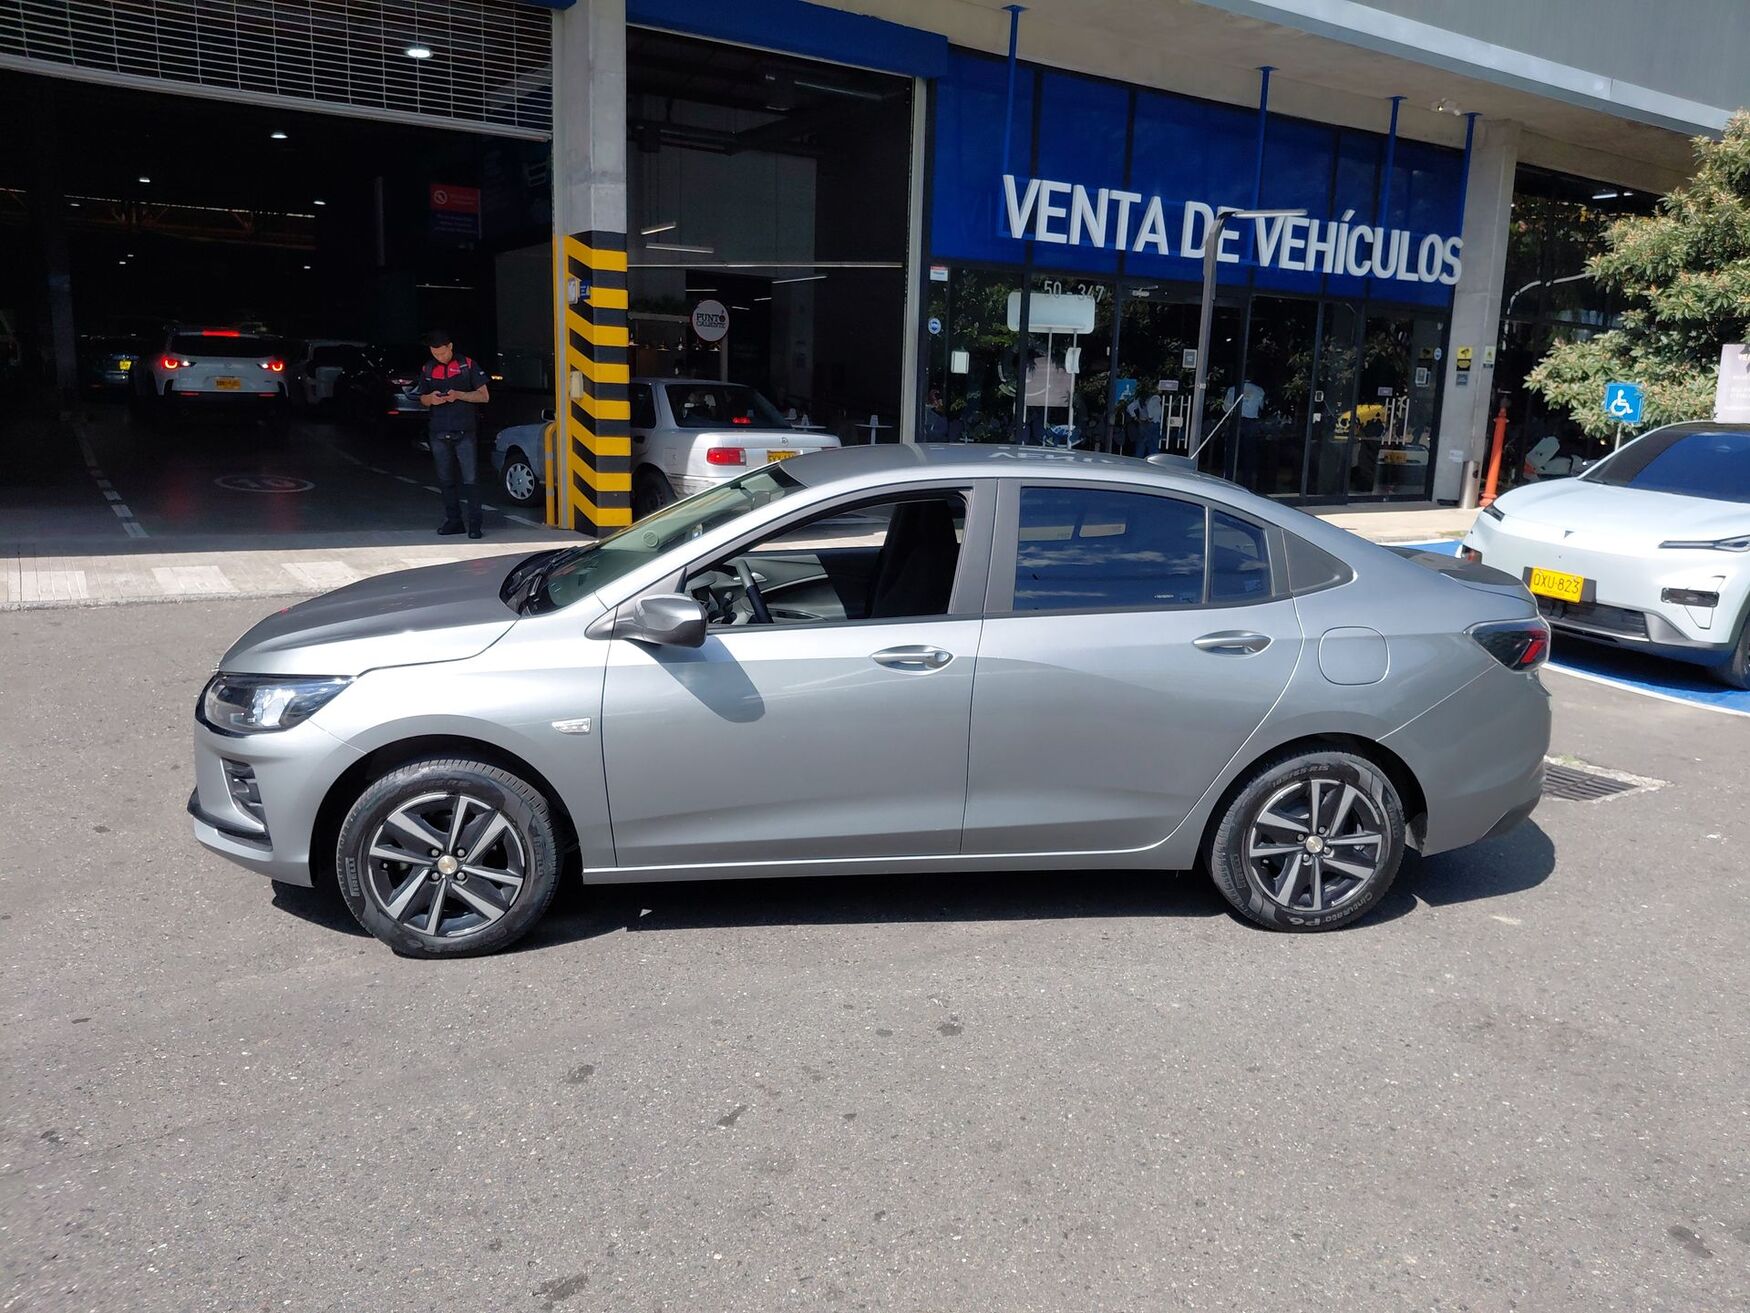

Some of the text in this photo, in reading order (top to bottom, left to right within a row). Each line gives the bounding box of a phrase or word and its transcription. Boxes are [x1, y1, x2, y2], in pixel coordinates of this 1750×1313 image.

[1003, 174, 1464, 285] VENTA DE VEHÍCULOS
[1044, 280, 1062, 299] 50
[1078, 284, 1105, 303] 347
[696, 312, 726, 323] PUNTO
